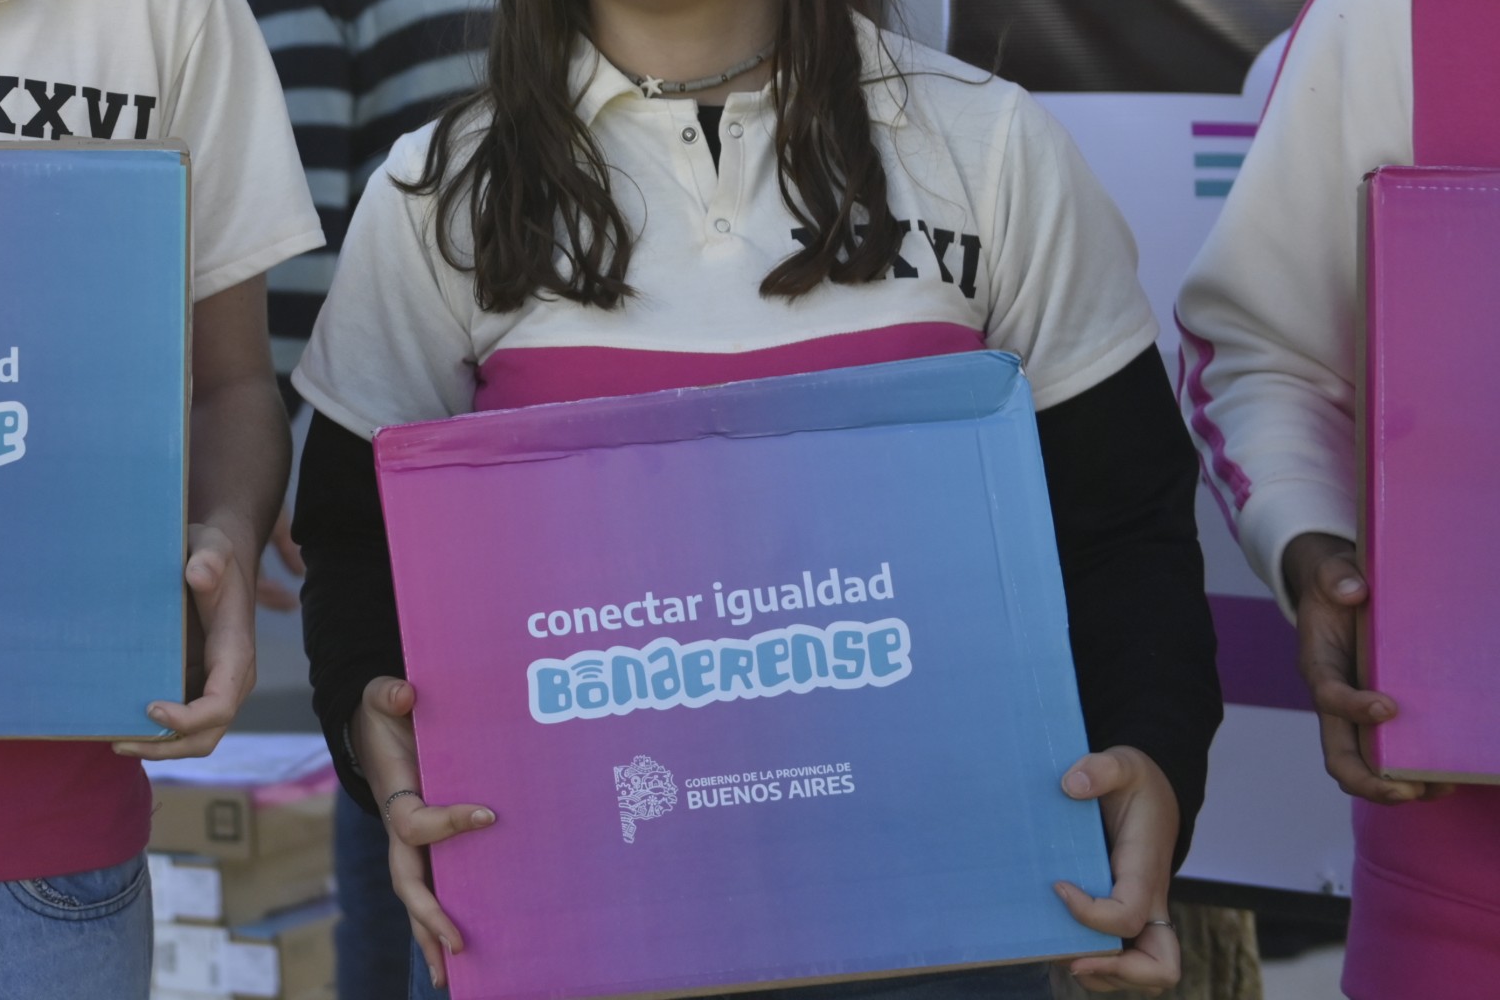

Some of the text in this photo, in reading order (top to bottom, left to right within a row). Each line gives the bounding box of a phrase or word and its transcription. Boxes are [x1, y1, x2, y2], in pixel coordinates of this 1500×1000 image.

[527, 562, 894, 638] conectar igualdad
[685, 762, 852, 788] GOBIERNO DE LA PROVINCIA DE
[686, 774, 855, 810] BUENOS AIRES
